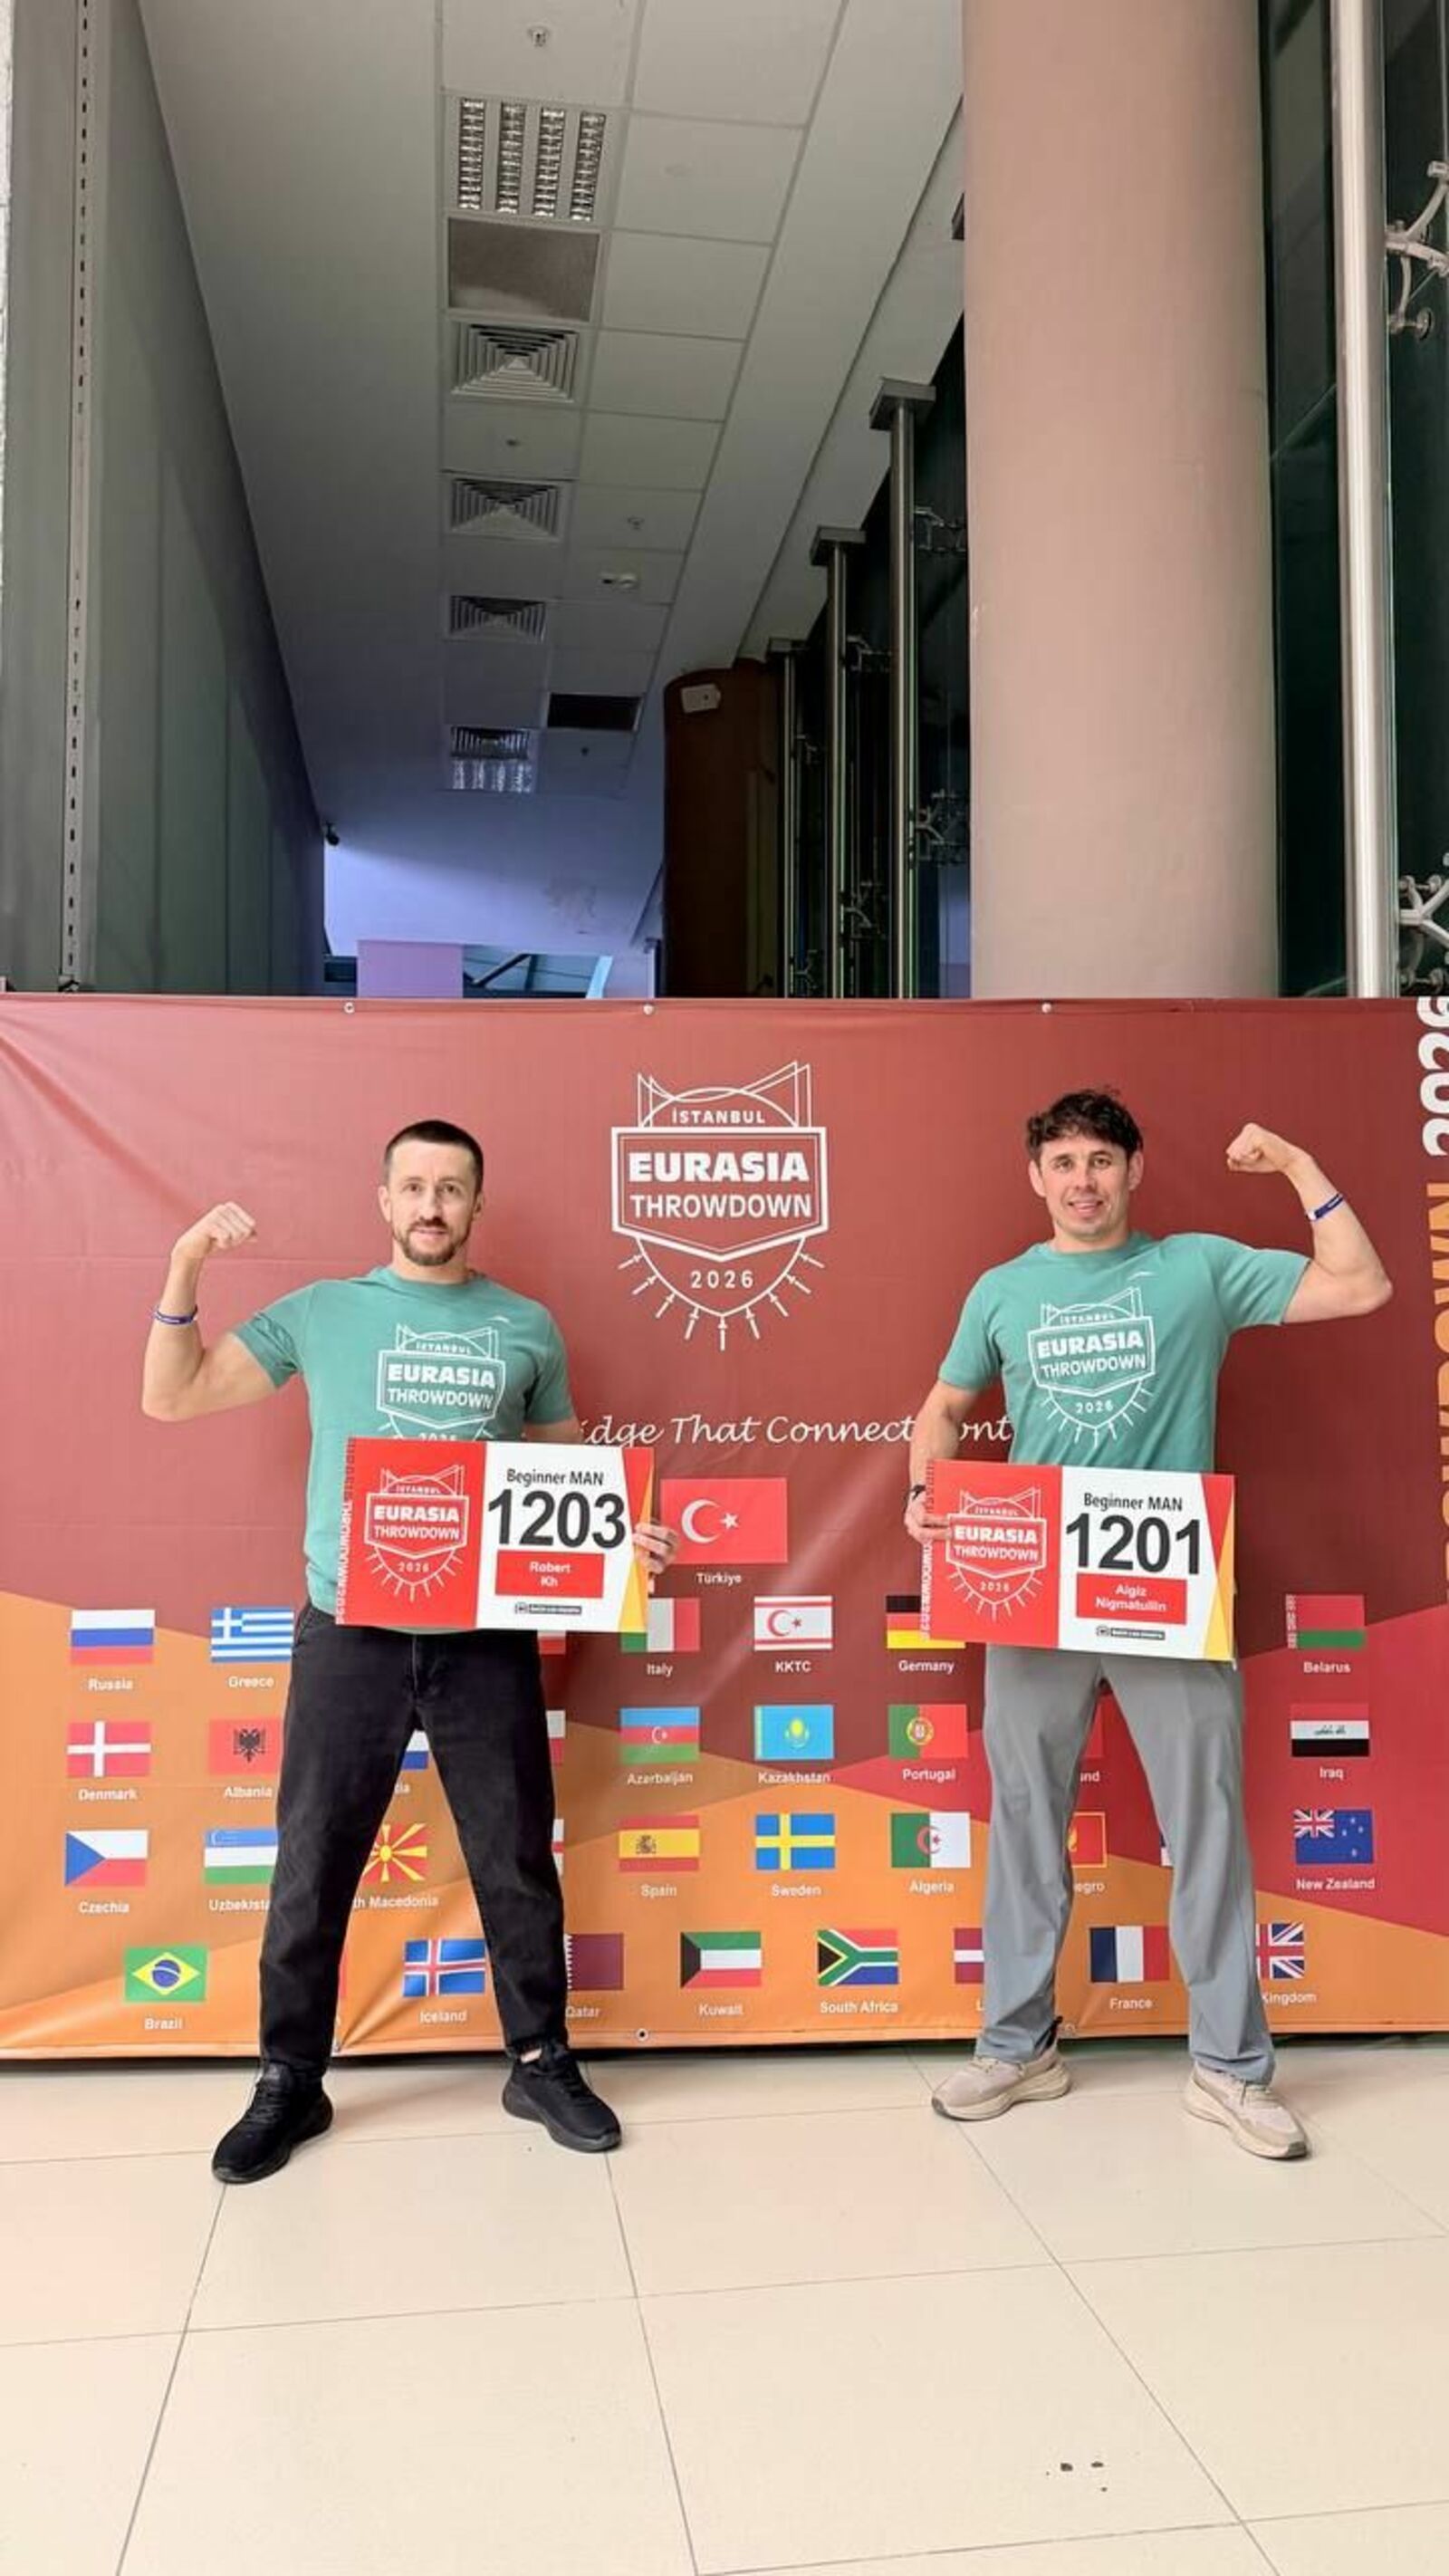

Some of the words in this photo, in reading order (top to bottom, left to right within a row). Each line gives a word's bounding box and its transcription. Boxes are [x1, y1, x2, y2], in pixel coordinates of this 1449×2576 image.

[629, 1152, 810, 1182] EURASIA
[629, 1194, 812, 1218] THROWDOWN
[690, 1271, 753, 1289] 2026
[1037, 1330, 1144, 1360] EURASIA
[1041, 1354, 1146, 1379] THROWDOWN
[388, 1363, 495, 1389] EURASIA
[387, 1388, 494, 1410] THROWDOWN
[1075, 1399, 1114, 1414] 2026
[581, 1415, 665, 1448] dge
[671, 1414, 762, 1444] That
[765, 1416, 916, 1443] Connect
[506, 1468, 565, 1487] Beginner
[569, 1471, 605, 1485] MAN
[1084, 1493, 1144, 1512] Beginner
[1147, 1496, 1183, 1511] MAN
[374, 1504, 459, 1523] EURASIA
[488, 1488, 626, 1549] 1203
[373, 1524, 459, 1540] THROWDOWN
[954, 1525, 1037, 1544] EURASIA
[1066, 1513, 1200, 1575] 1201
[954, 1545, 1039, 1562] THROWDOWN
[529, 1561, 571, 1573] Robert
[696, 1572, 742, 1586] Türkiye
[646, 1662, 673, 1677] Italy
[774, 1659, 811, 1673] KKTC
[897, 1659, 955, 1675] Germany
[1302, 1660, 1351, 1674] Belarus
[88, 1677, 133, 1690] Russia
[227, 1676, 274, 1688] Greece
[627, 1771, 694, 1786] Azerbaijan
[757, 1771, 831, 1784] Kazakhstan
[902, 1767, 956, 1783] Portugal
[1319, 1767, 1344, 1782] Iraq
[78, 1788, 138, 1801] Denmark
[224, 1786, 273, 1798] Albania
[639, 1883, 677, 1898] Spain
[771, 1883, 821, 1897] Sweden
[909, 1879, 955, 1895] Algeria
[1296, 1879, 1323, 1890] New
[1326, 1878, 1376, 1890] Zealand
[78, 1901, 130, 1914] Czechia
[369, 1894, 439, 1908] Macedonia
[698, 2003, 744, 2016] Kuwait
[820, 2001, 859, 2014] South
[861, 2000, 898, 2014] Africa
[1108, 1996, 1152, 2010] France
[144, 2017, 183, 2030] Brazil
[419, 2009, 467, 2023] Iceland
